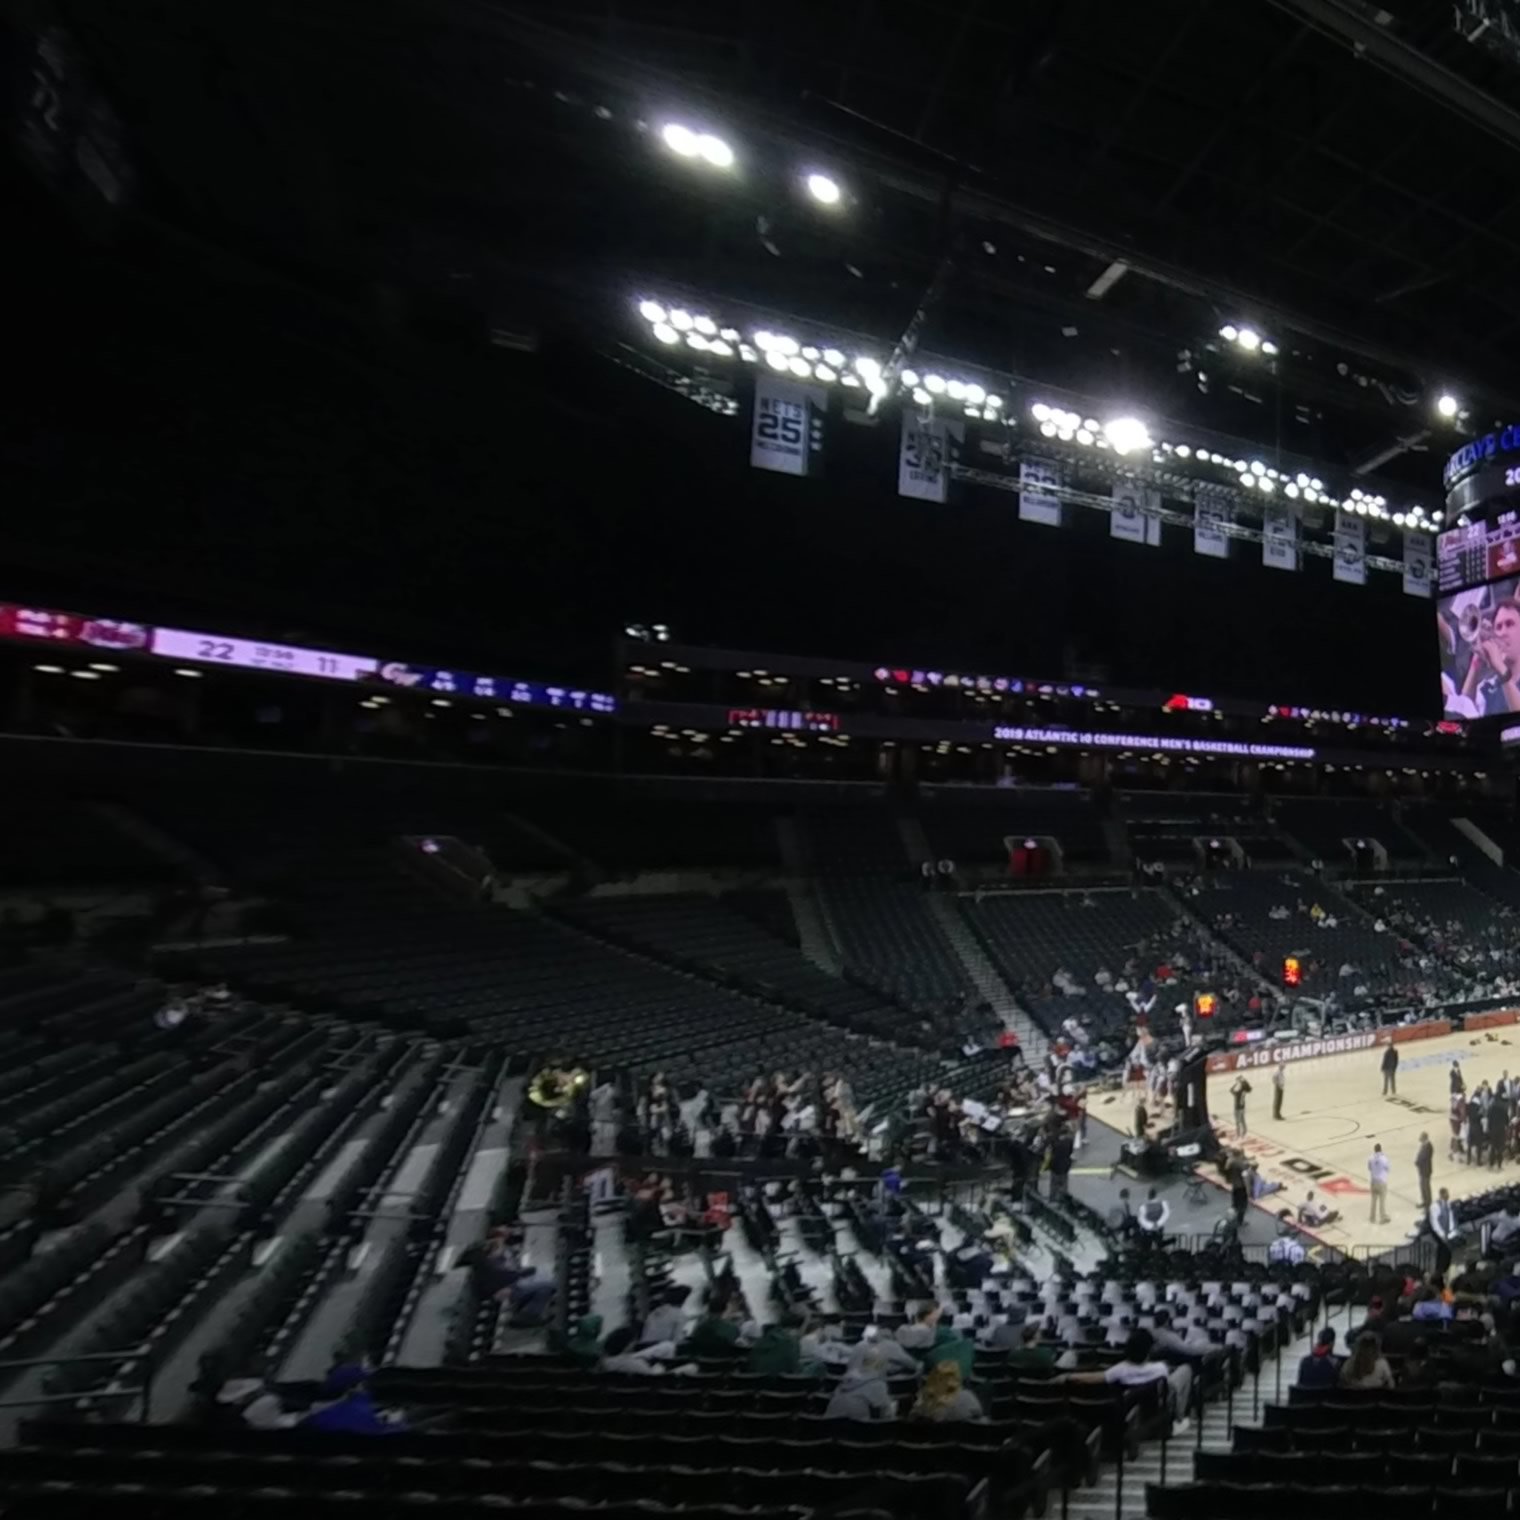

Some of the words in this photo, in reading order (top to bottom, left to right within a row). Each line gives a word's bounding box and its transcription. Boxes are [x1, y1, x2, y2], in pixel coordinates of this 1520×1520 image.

[758, 413, 802, 444] 25
[1467, 525, 1480, 539] 22
[198, 640, 235, 660] 22
[317, 656, 338, 674] 11
[994, 727, 1023, 740] 2019
[1025, 728, 1078, 744] ATLANTIC
[1080, 732, 1092, 744] 10
[1093, 733, 1159, 748] CONFERENCE
[1160, 738, 1191, 751] MEN'S
[1192, 740, 1249, 754] BASKETBALL
[1250, 744, 1315, 759] CHAMPIONSHIP
[1236, 1050, 1270, 1069] A-10
[1272, 1033, 1377, 1062] CHAMPIONSHIP
